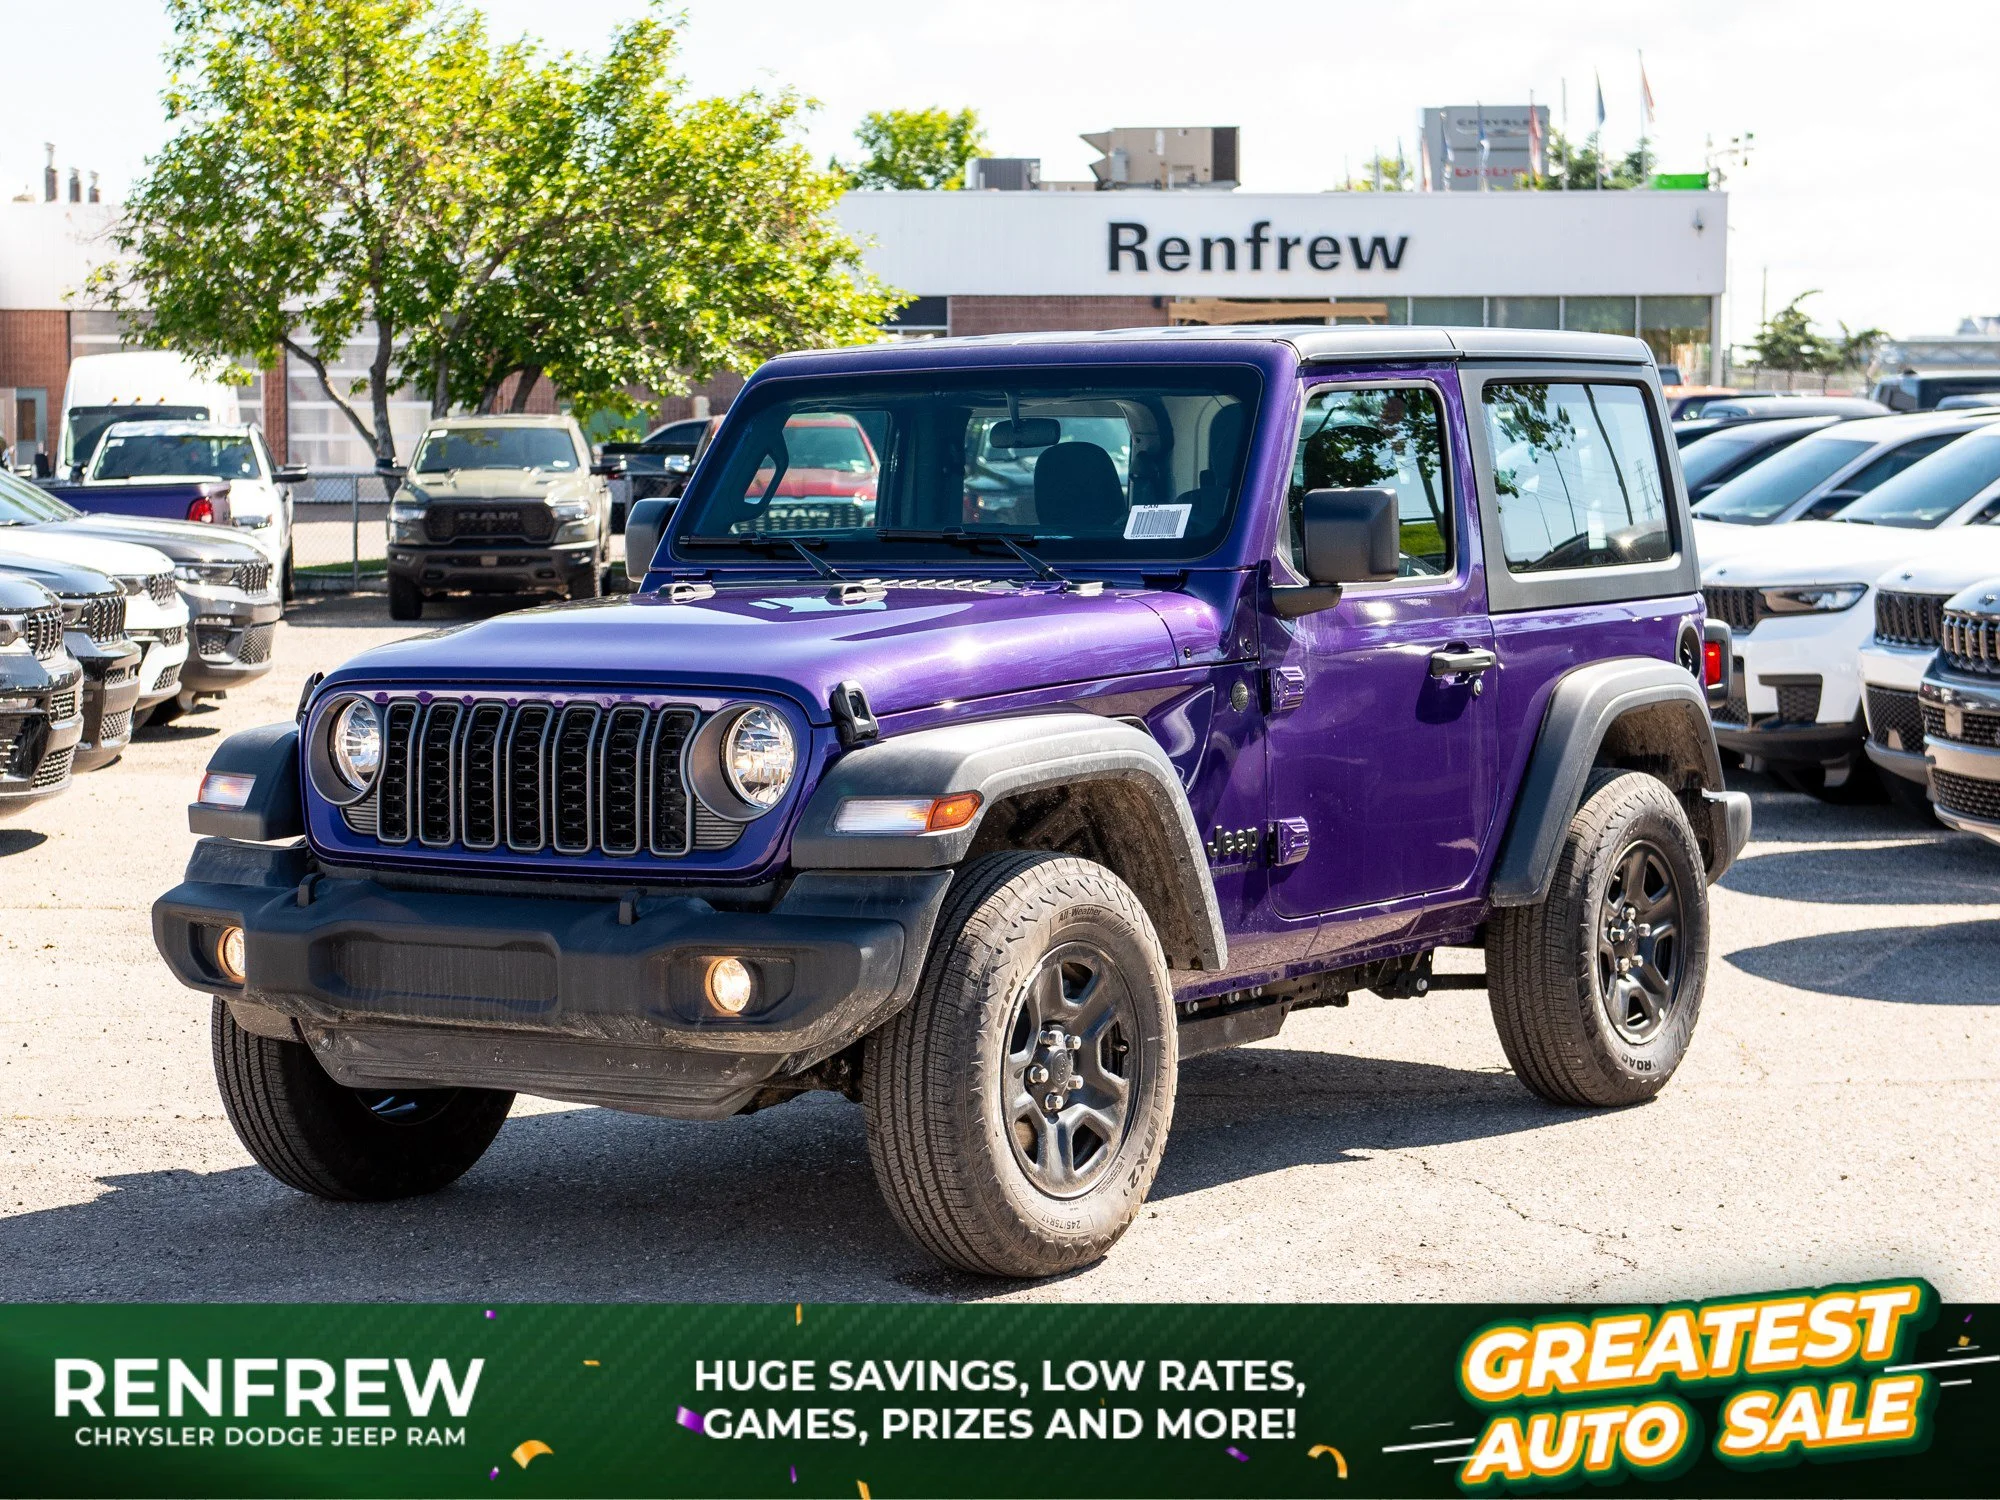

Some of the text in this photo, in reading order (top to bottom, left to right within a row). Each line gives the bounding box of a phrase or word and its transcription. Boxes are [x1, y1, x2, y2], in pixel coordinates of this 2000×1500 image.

[1108, 221, 1409, 272] Renfrew
[459, 511, 519, 520] RAM
[1207, 825, 1260, 858] Jeep
